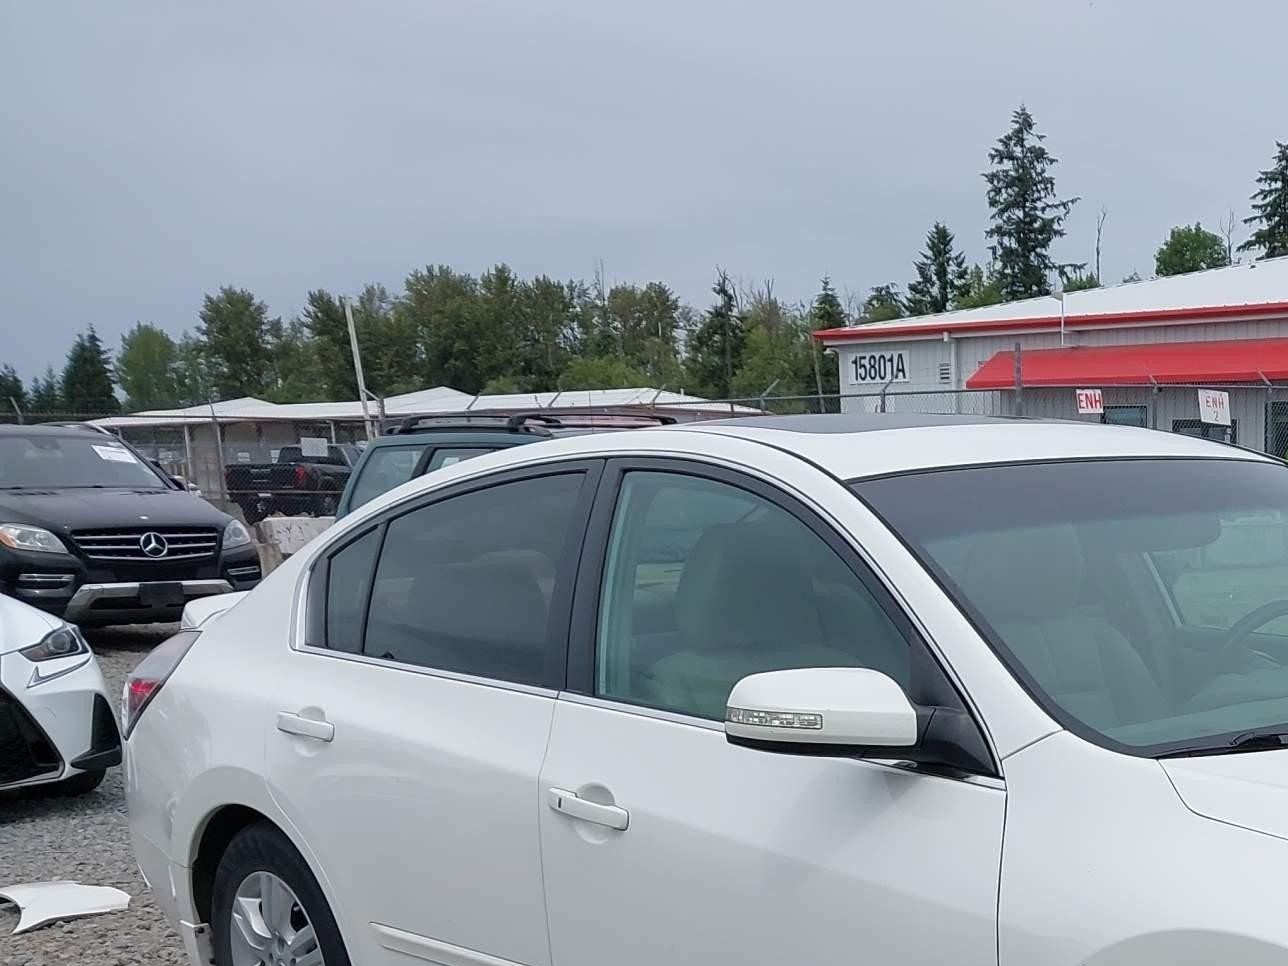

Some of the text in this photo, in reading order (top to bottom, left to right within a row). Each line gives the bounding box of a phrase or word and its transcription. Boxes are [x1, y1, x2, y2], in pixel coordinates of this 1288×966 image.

[851, 353, 907, 381] 15801A
[1077, 393, 1103, 409] ENH
[1205, 395, 1225, 409] ENH
[1213, 410, 1221, 421] 2
